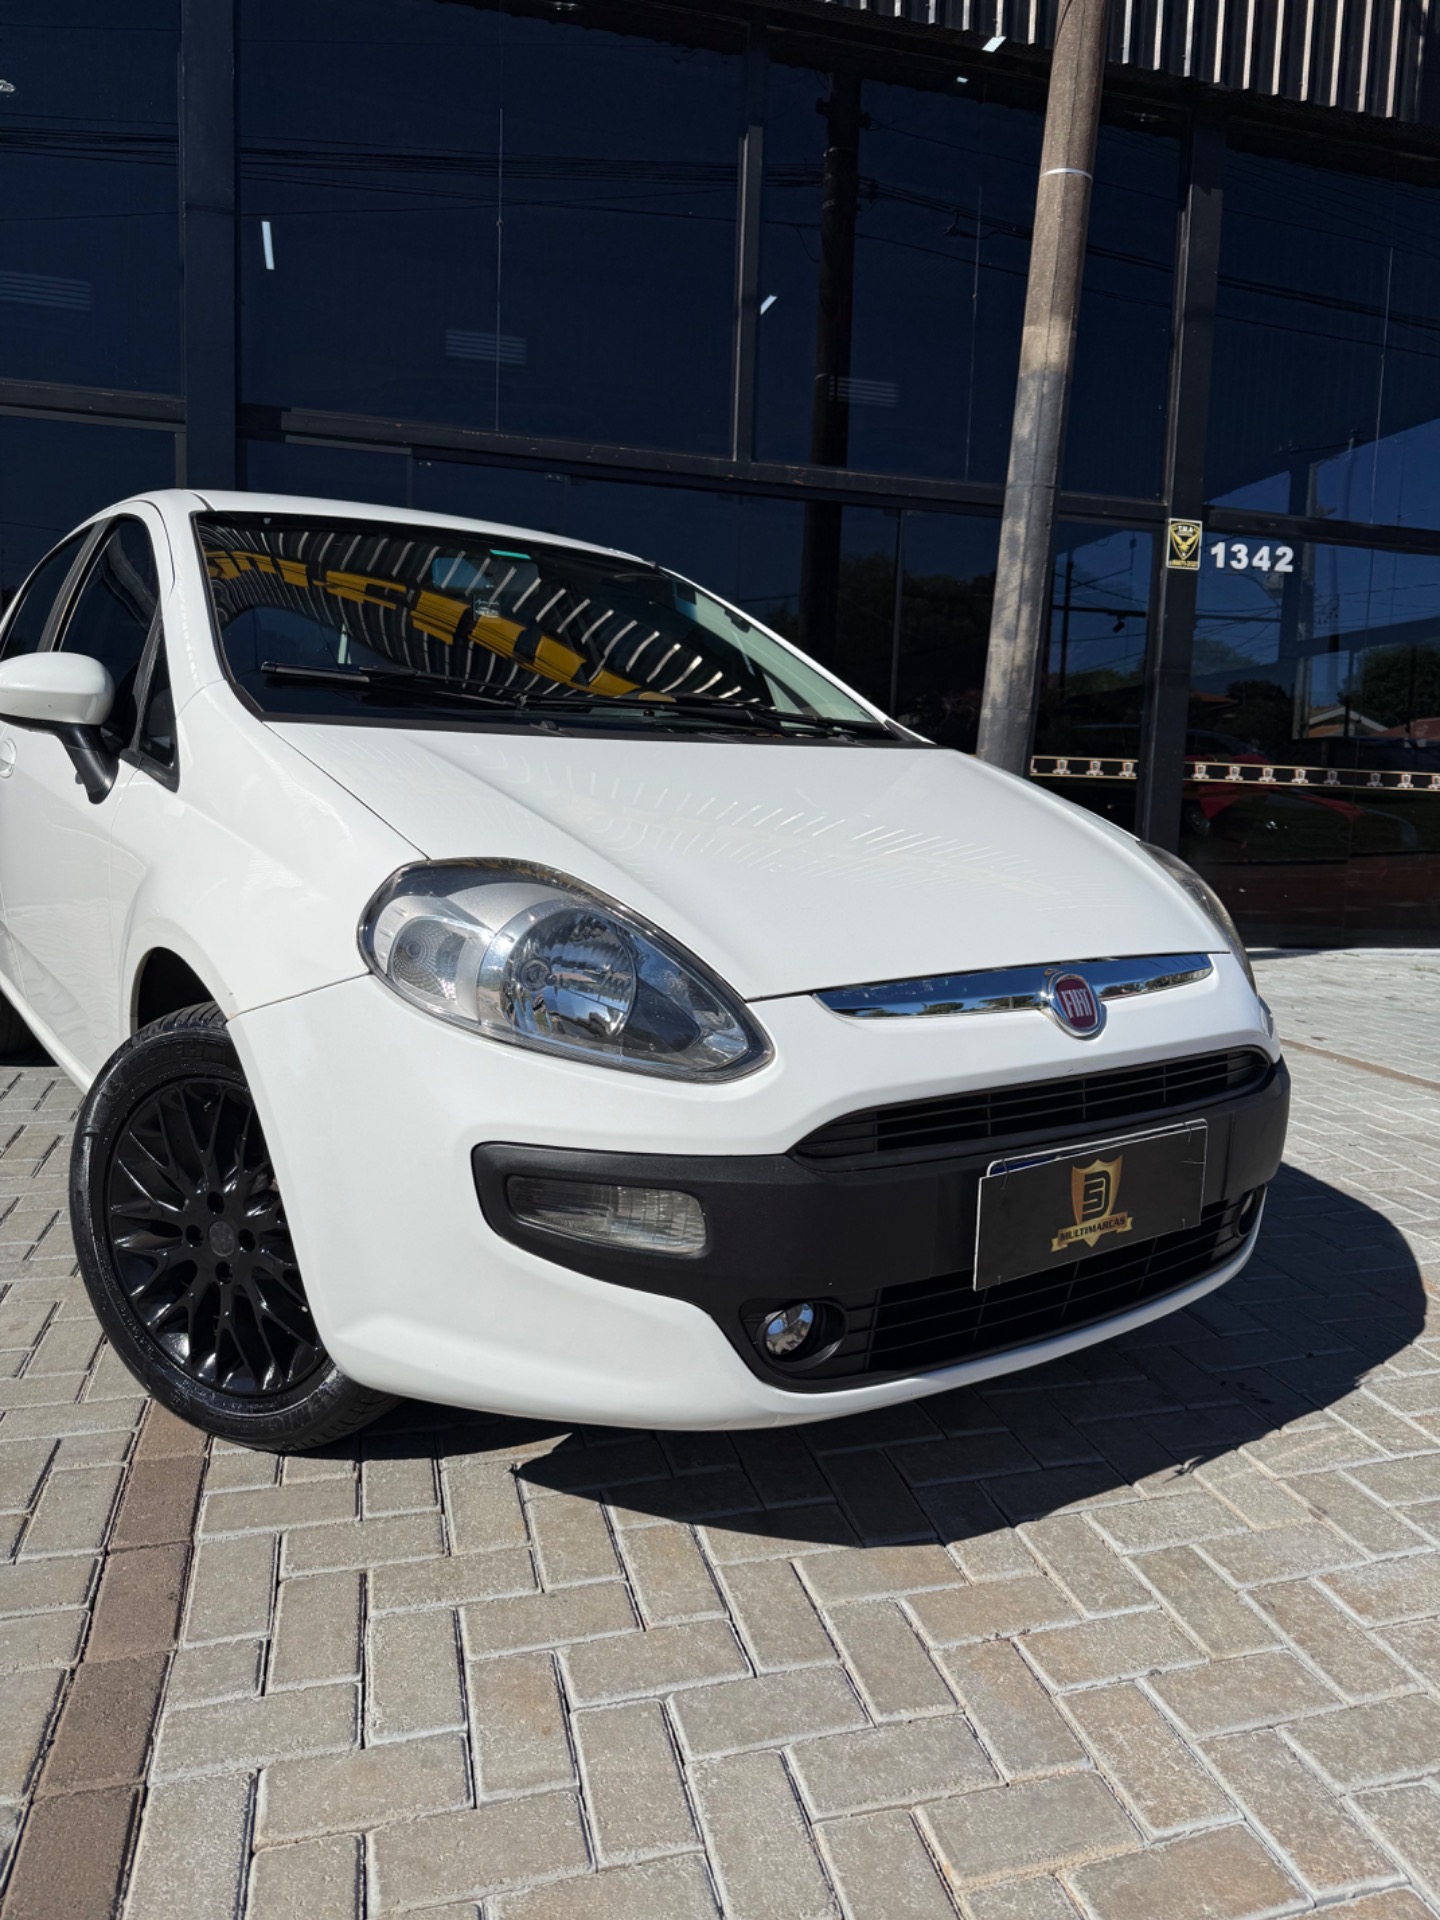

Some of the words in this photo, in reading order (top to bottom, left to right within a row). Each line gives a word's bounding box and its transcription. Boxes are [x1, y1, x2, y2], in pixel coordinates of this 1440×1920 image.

[1211, 542, 1294, 572] 1342
[1060, 988, 1093, 1018] FIAT
[1059, 1215, 1126, 1242] MULTIMARCAS
